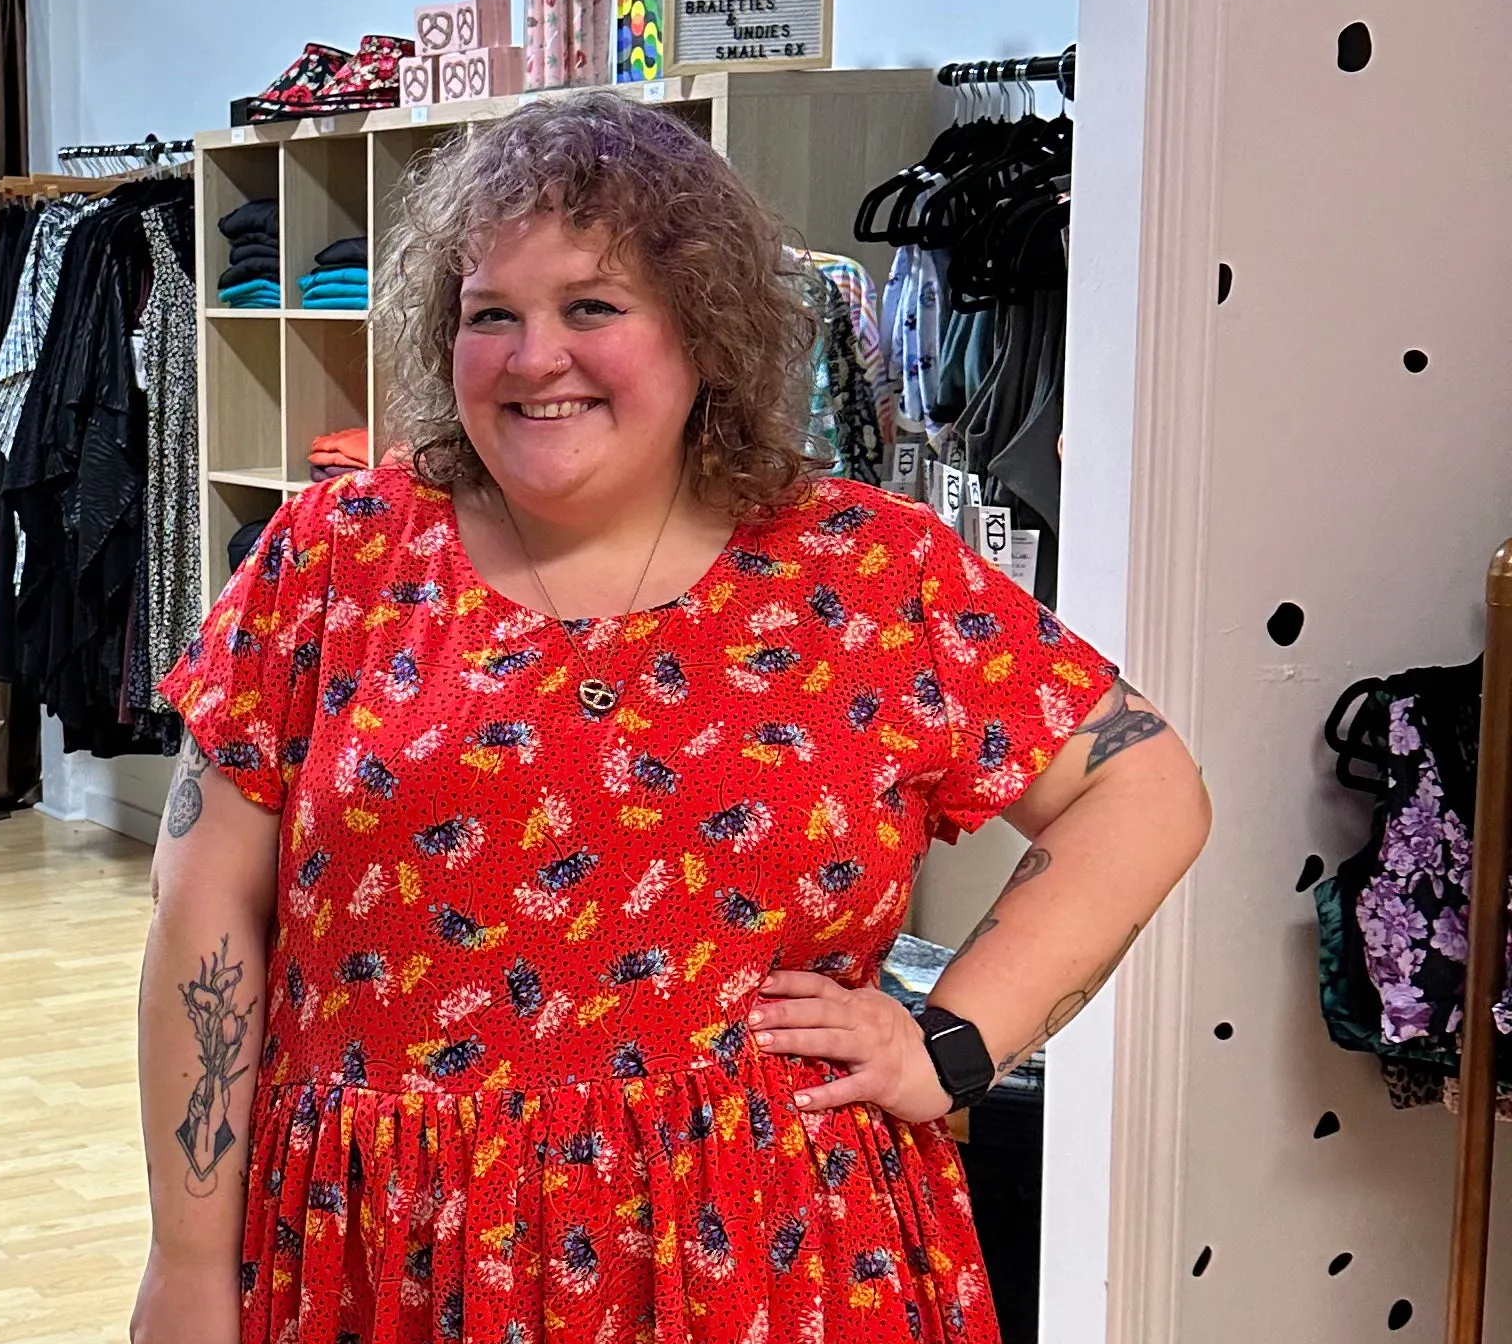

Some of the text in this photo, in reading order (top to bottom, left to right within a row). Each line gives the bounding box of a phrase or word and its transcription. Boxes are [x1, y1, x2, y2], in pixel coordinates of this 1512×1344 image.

[726, 13, 737, 26] &
[733, 24, 791, 40] UNDIES
[986, 512, 1006, 552] KD
